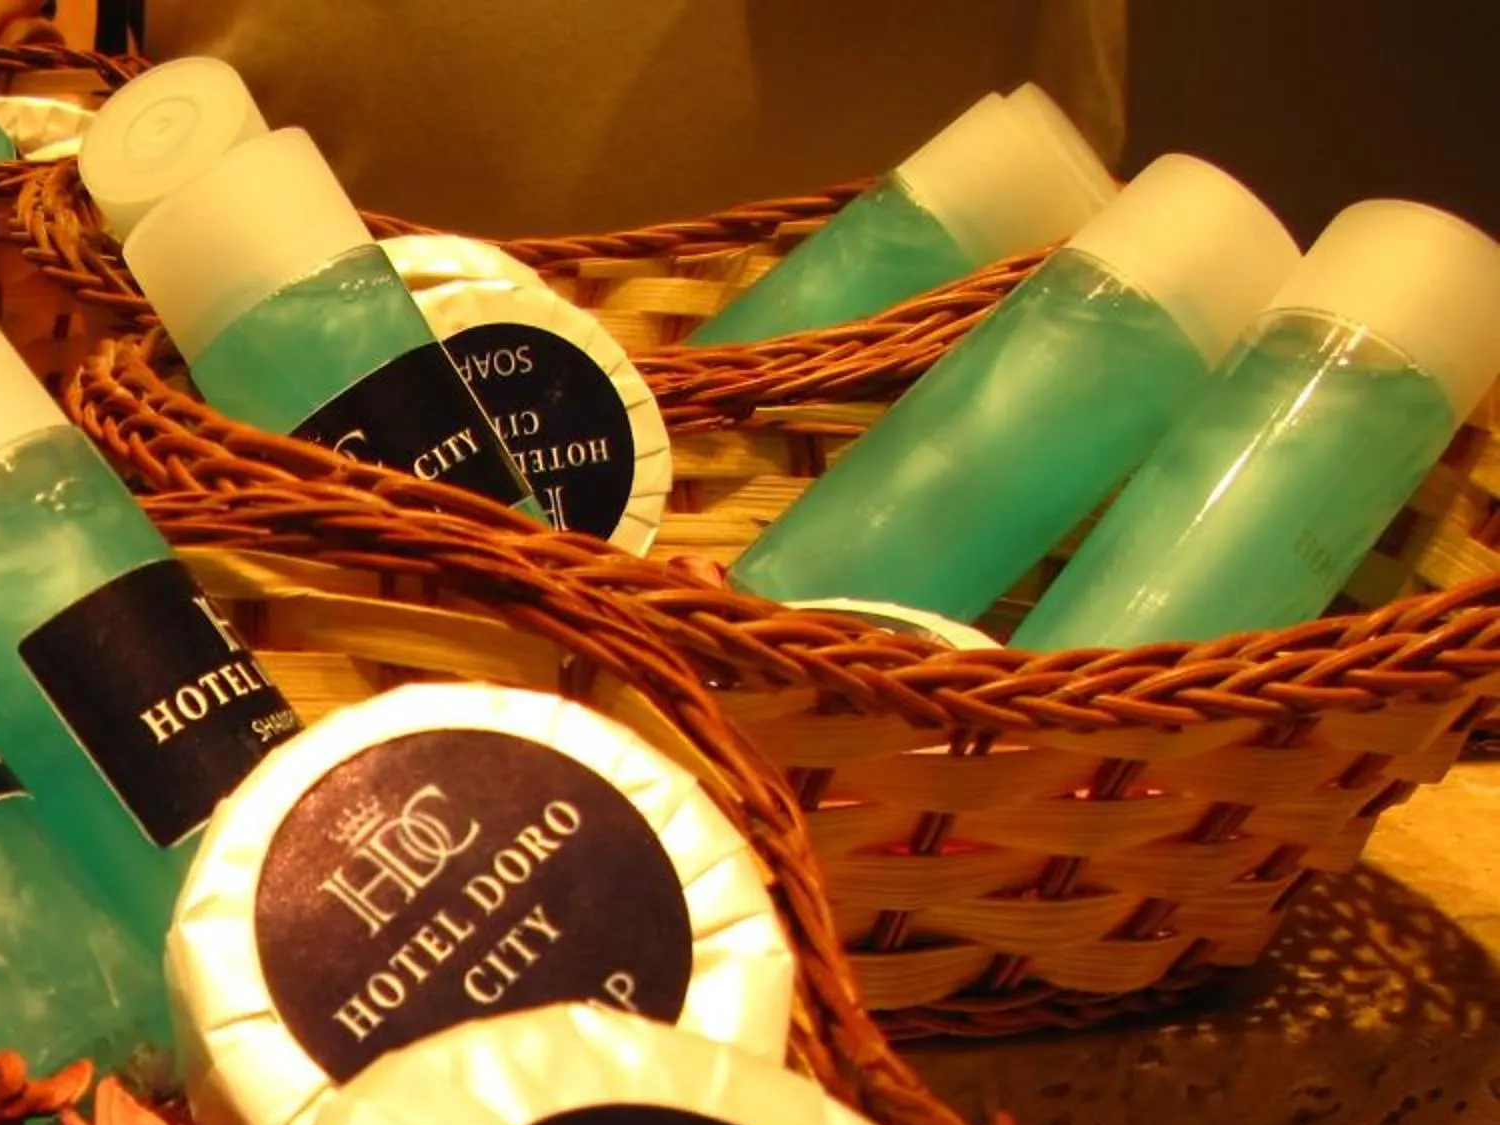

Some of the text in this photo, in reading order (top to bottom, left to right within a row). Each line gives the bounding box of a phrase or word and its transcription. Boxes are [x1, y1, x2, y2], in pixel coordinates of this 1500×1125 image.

[413, 428, 480, 481] CITY
[140, 661, 262, 745] HOTEL
[331, 798, 583, 1042] HOTEL DORO
[462, 904, 564, 1005] CITY
